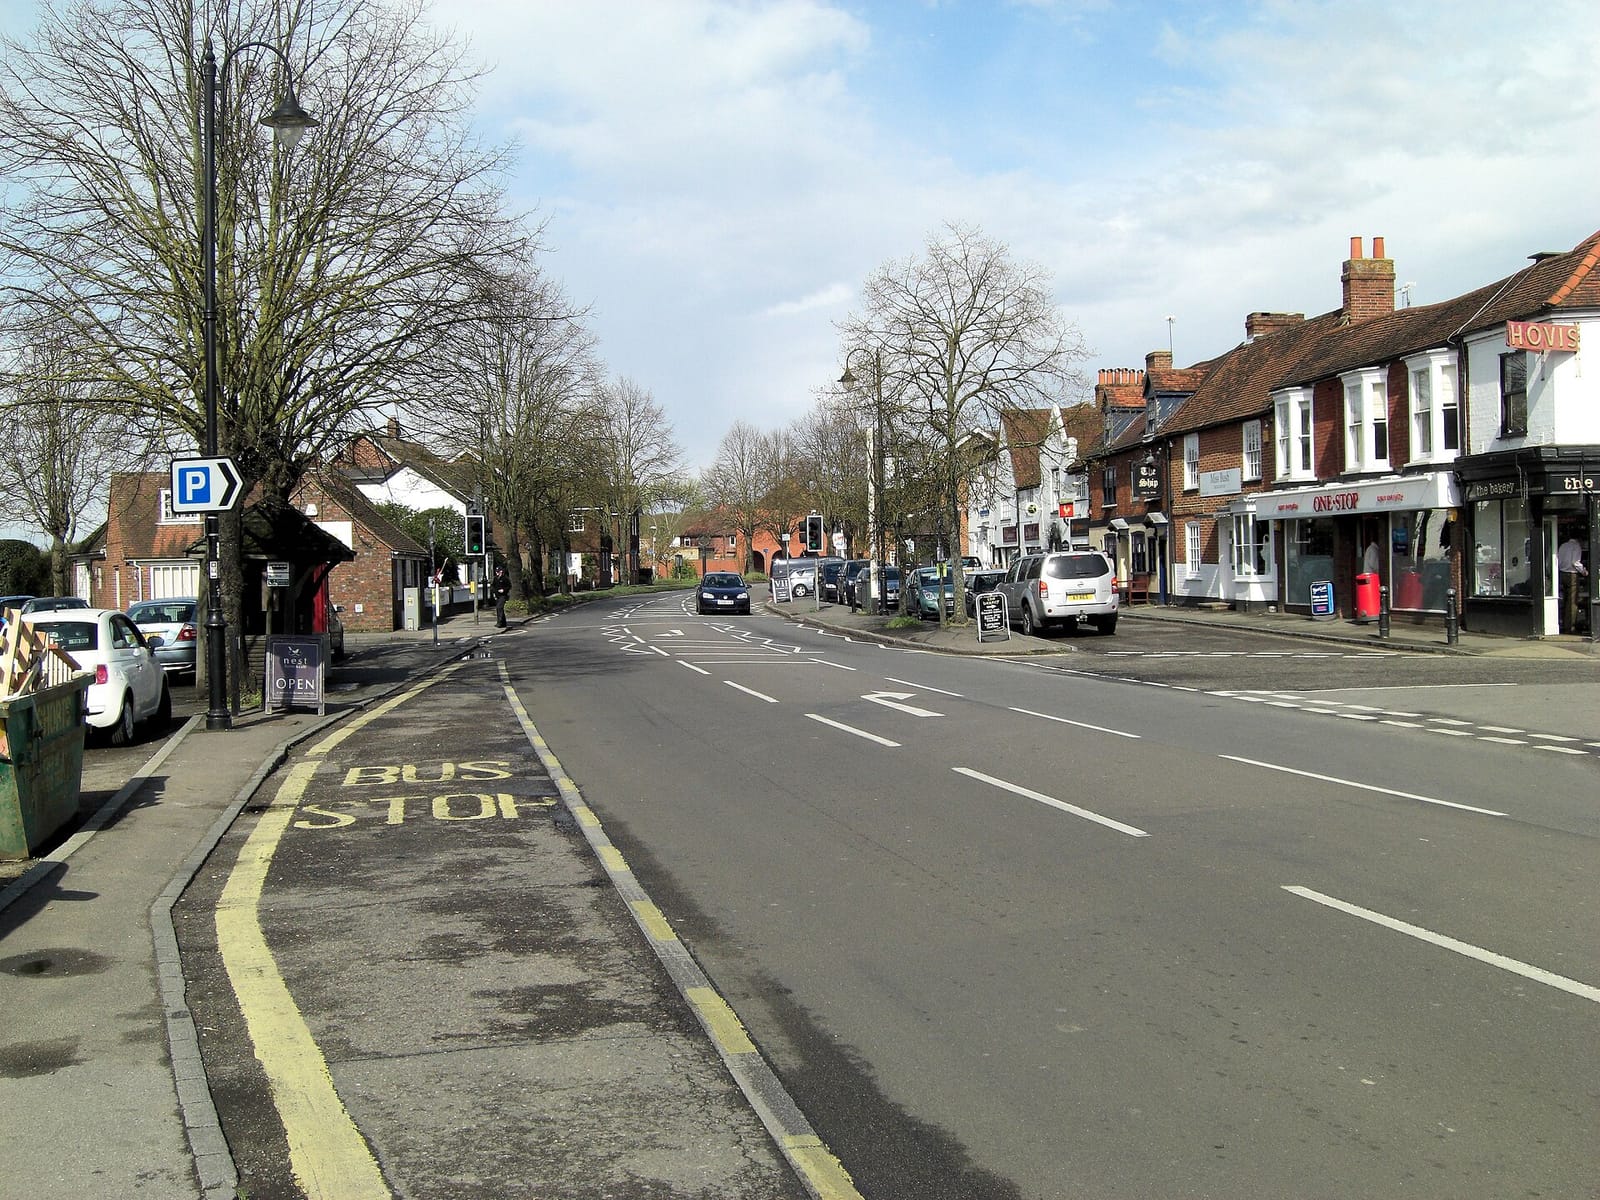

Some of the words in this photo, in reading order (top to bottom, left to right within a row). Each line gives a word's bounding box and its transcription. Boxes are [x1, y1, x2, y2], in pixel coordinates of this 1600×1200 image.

[1511, 324, 1577, 348] HOVIS
[1140, 466, 1157, 477] The
[186, 471, 206, 501] P
[1138, 478, 1159, 489] Ship
[1476, 485, 1488, 497] the
[1489, 482, 1515, 495] bakery
[1564, 477, 1594, 491] the
[283, 657, 307, 665] nest
[276, 678, 315, 690] OPEN
[342, 761, 513, 787] BUS
